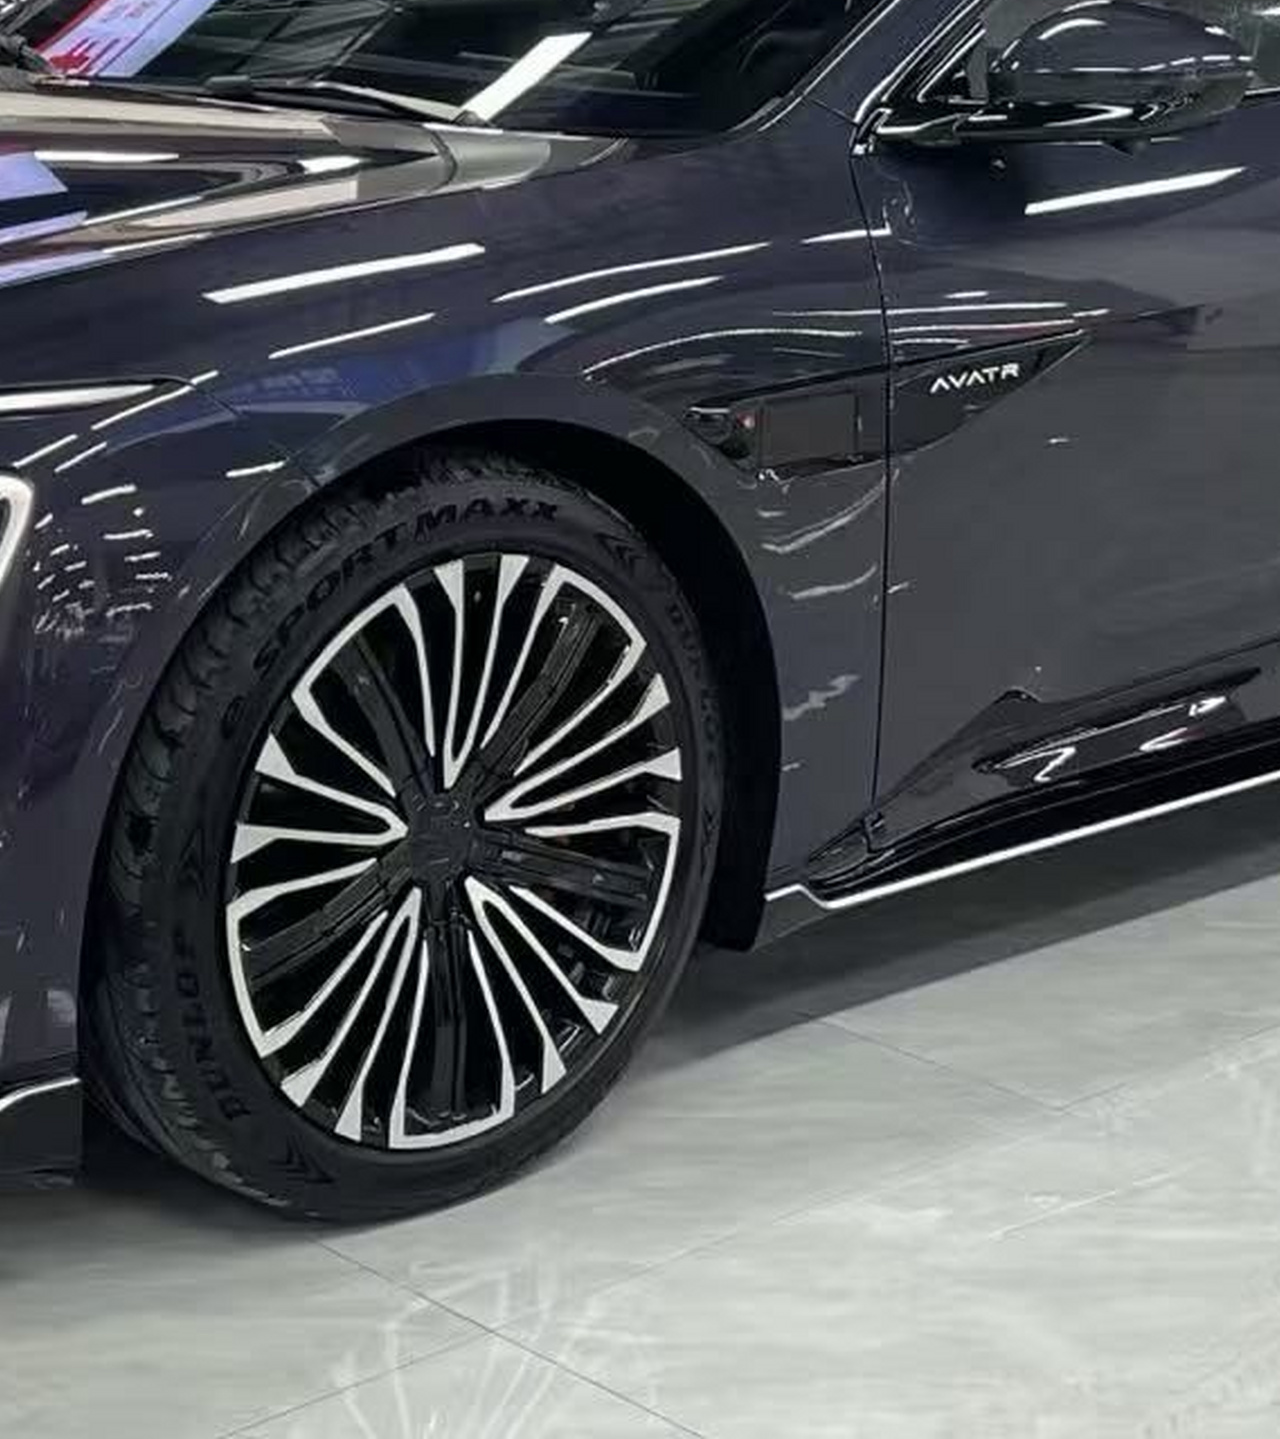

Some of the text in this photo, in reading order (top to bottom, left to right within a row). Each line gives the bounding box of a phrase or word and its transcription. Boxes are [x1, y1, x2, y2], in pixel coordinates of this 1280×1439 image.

[929, 363, 1019, 394] AVATR
[252, 497, 558, 677] SPORT MAXX
